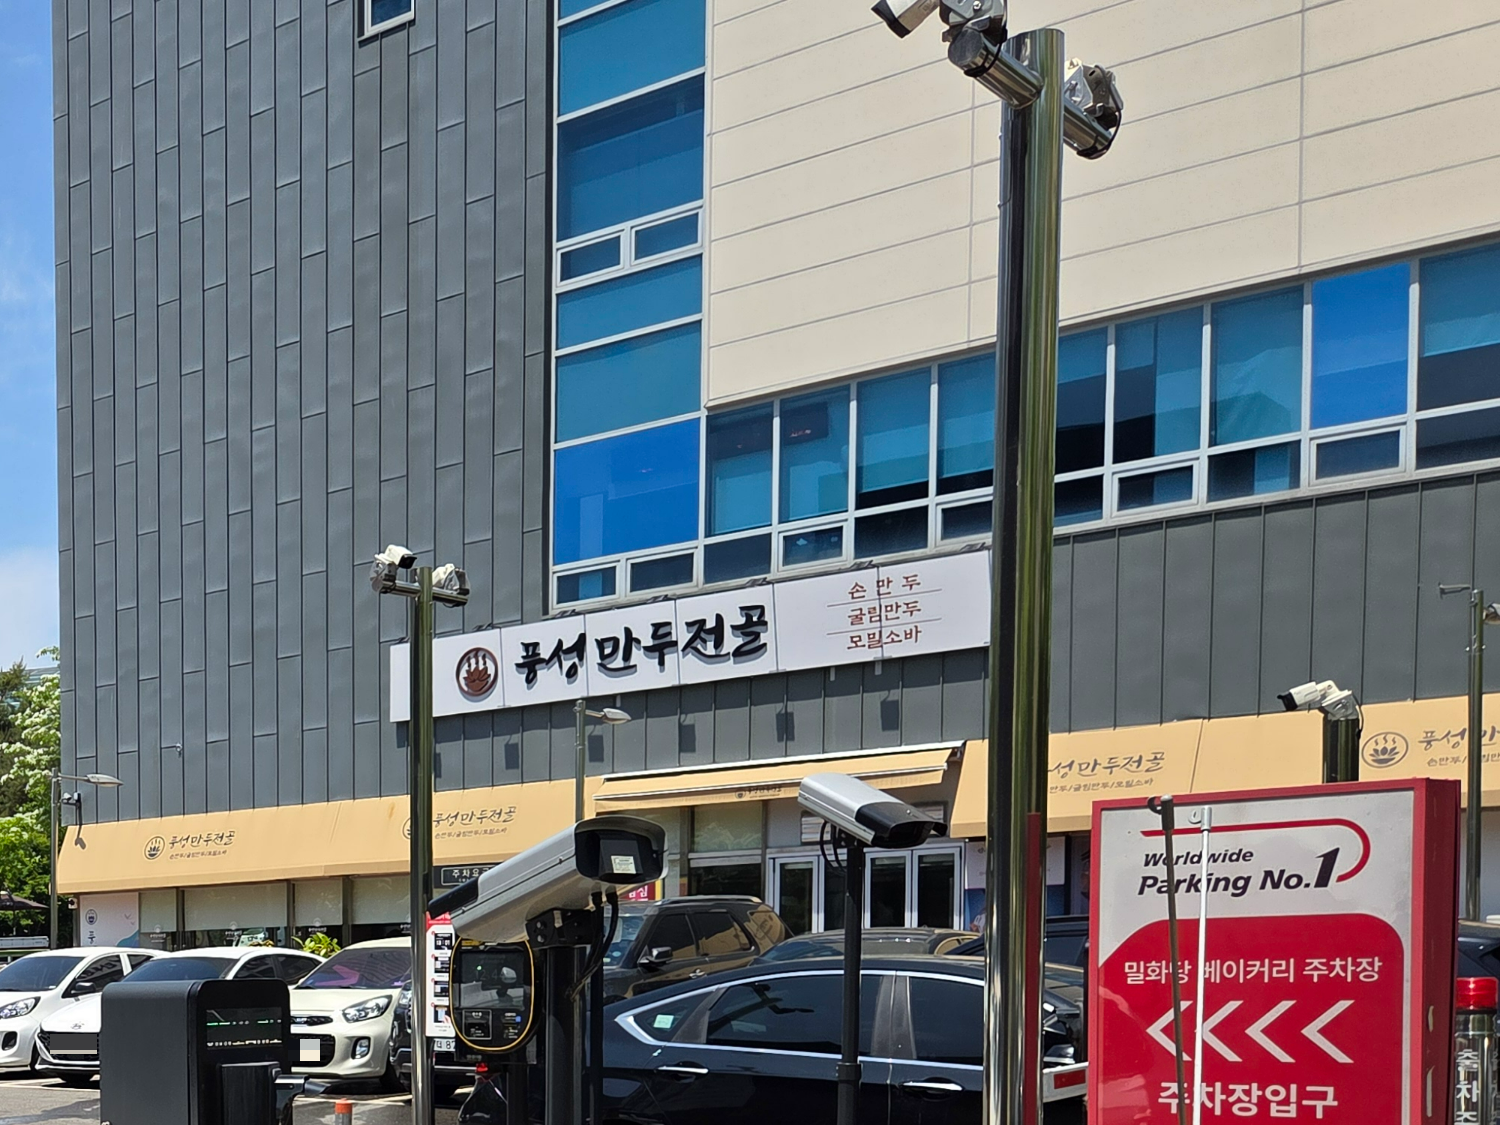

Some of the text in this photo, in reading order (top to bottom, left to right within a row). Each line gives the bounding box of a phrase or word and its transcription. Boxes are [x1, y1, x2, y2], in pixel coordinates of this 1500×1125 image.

[847, 600, 922, 626] 굴림만두
[847, 625, 922, 650] 모밀소바
[1048, 752, 1165, 779] 성만두전골
[1138, 872, 1252, 898] Parking
[1124, 956, 1383, 985] 밀화당 베이커리 주차장
[1158, 1081, 1339, 1119] 주차장입구
